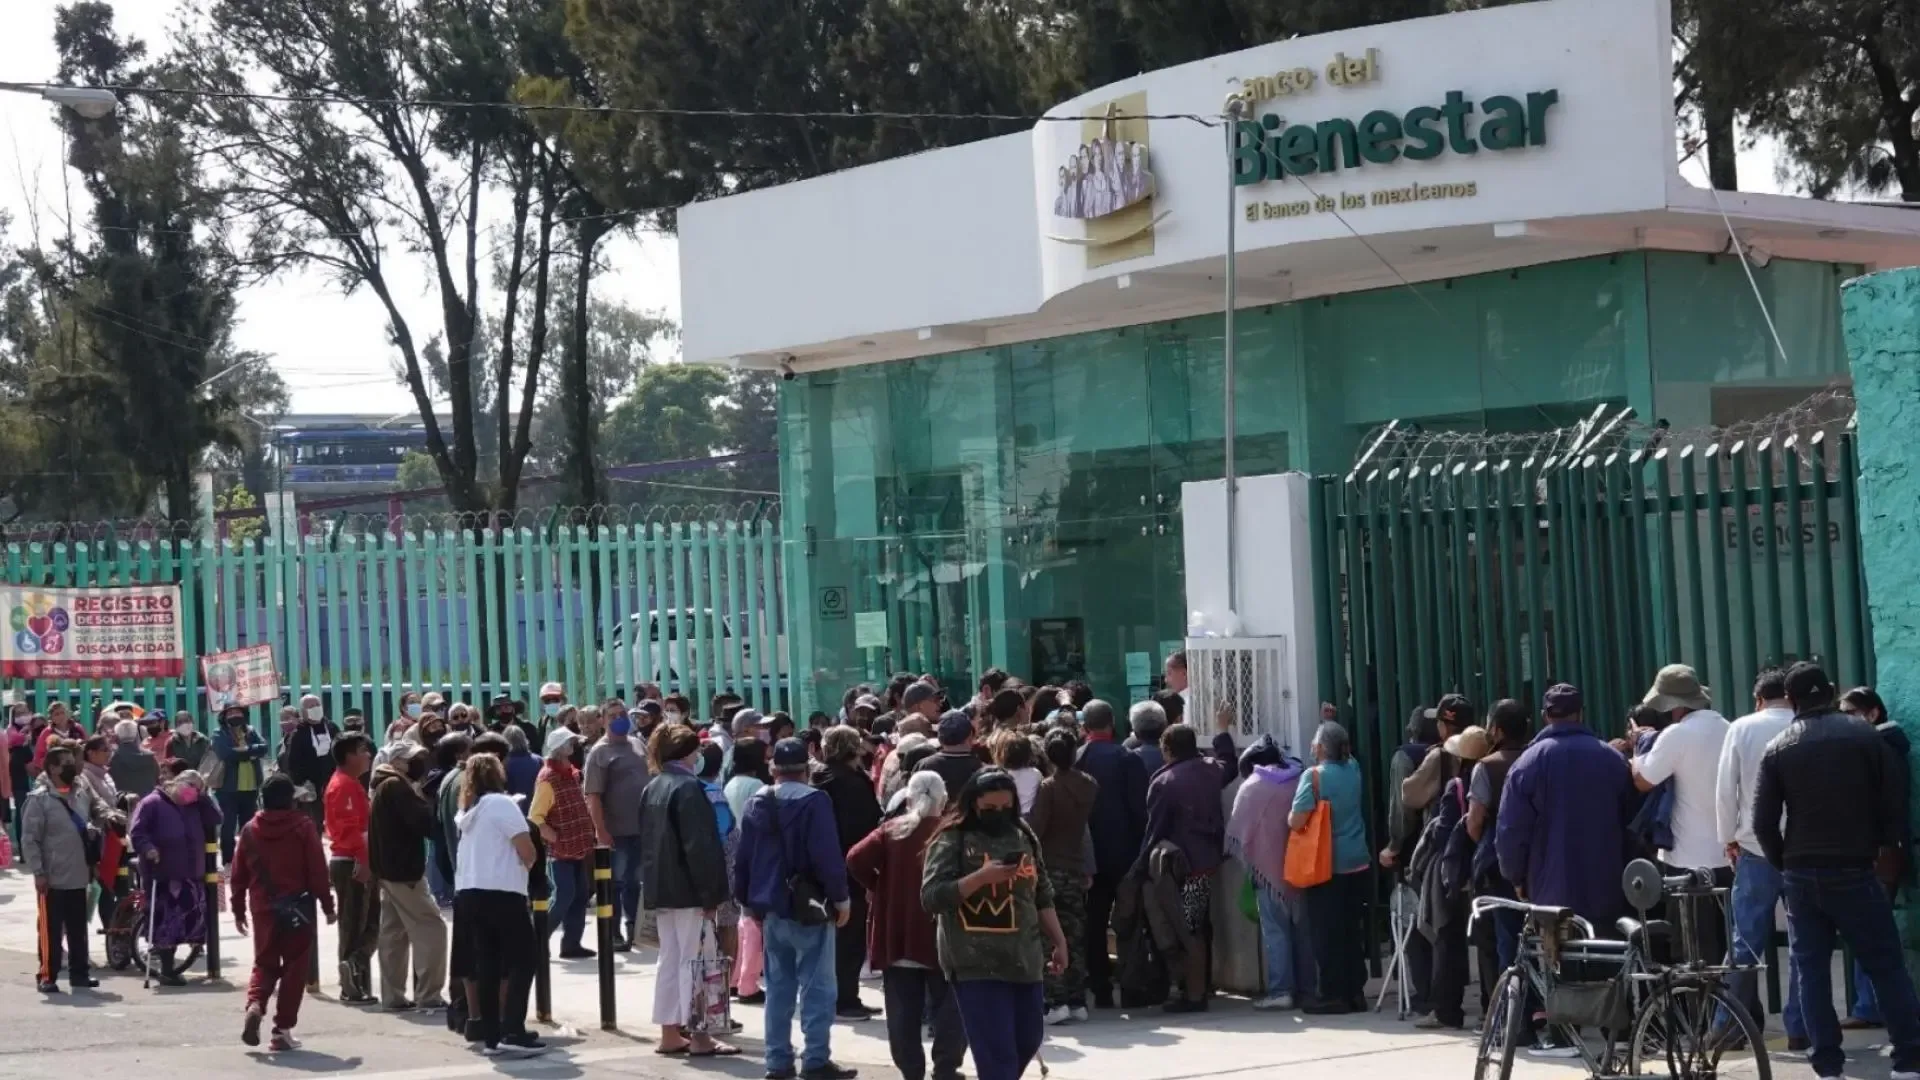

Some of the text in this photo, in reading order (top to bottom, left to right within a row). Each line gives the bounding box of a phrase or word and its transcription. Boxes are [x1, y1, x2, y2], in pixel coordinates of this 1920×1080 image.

[1240, 47, 1378, 103] anco del
[1234, 88, 1559, 186] Bienestar
[1245, 181, 1478, 222] El banco de los mexicanos
[74, 595, 173, 612] REGISTRO
[77, 612, 173, 625] DE SOLICITANTES
[77, 643, 175, 655] DISCAPACIDAD
